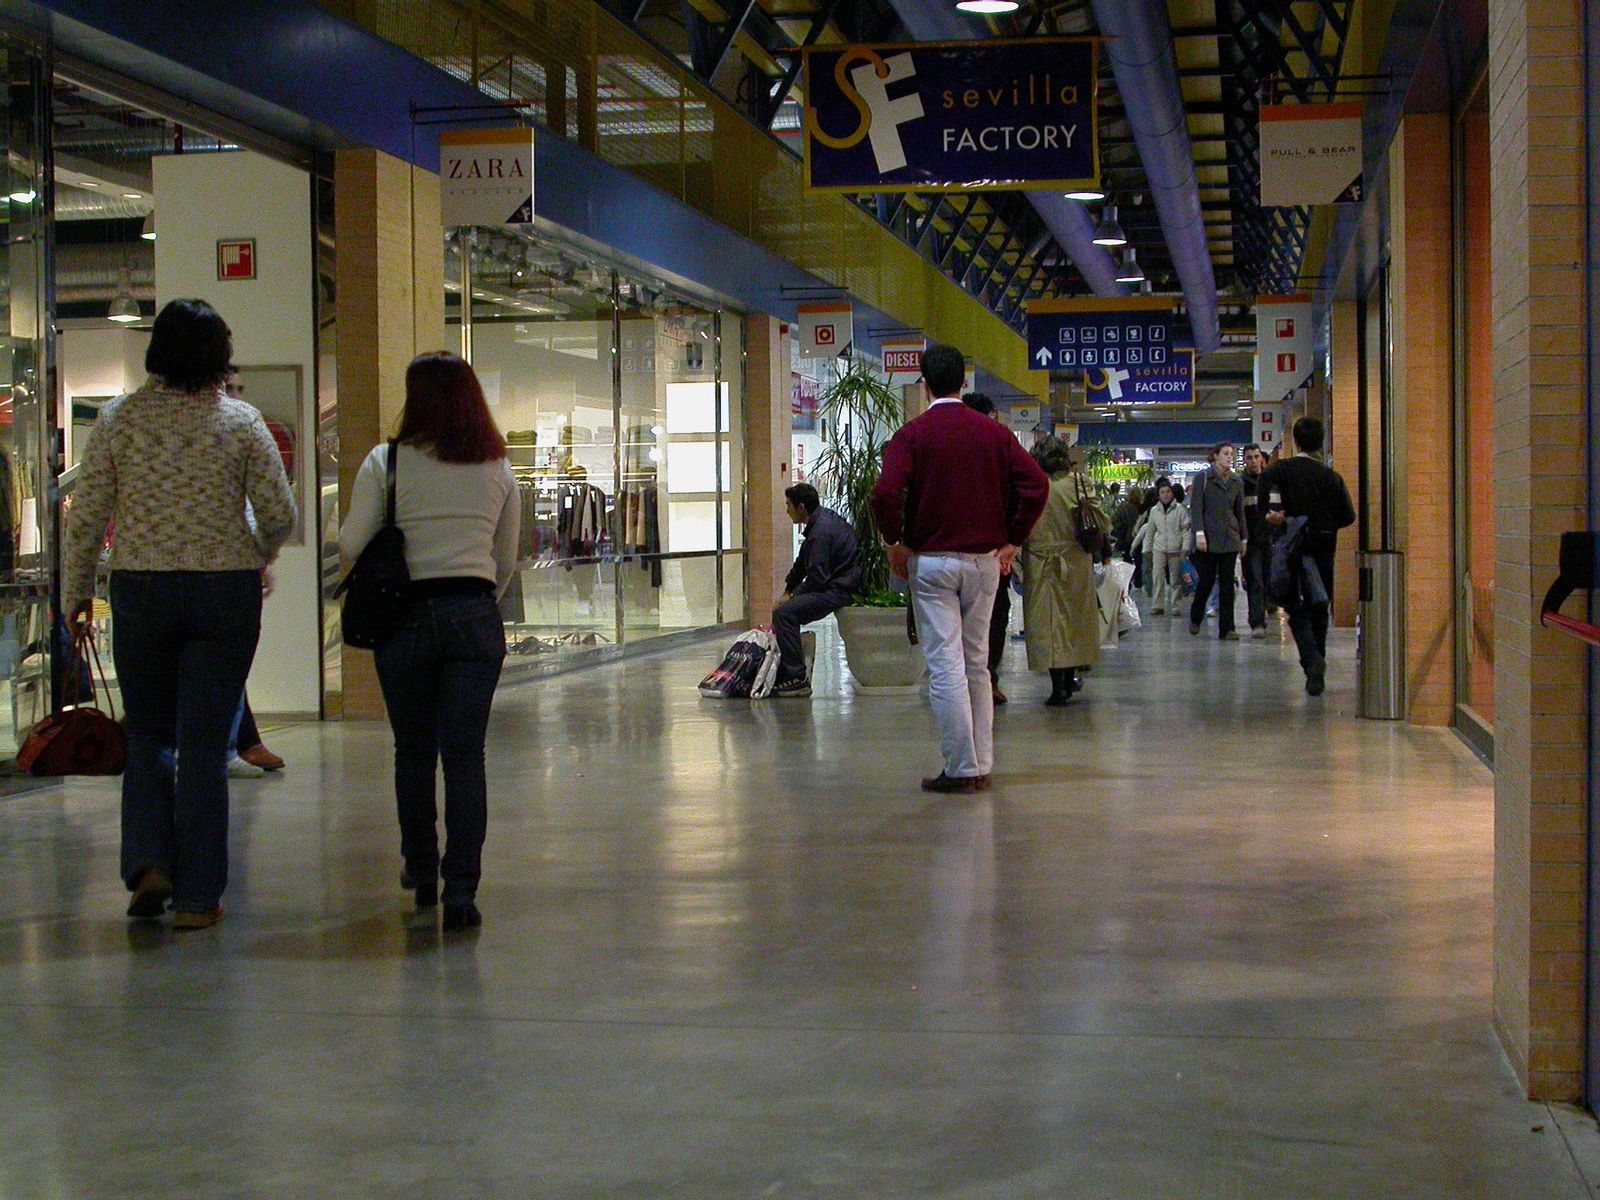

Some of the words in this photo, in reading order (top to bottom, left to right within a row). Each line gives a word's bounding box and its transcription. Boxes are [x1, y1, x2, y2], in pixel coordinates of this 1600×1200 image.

[942, 73, 1078, 109] sevilla
[943, 124, 1078, 152] FACTORY
[1270, 148, 1302, 156] PULL
[1308, 147, 1317, 156] &
[1322, 145, 1356, 154] BEAR
[448, 157, 524, 178] ZARA
[886, 352, 921, 368] DIESEL
[1135, 363, 1187, 376] sevilla
[1135, 381, 1187, 393] FACTORY
